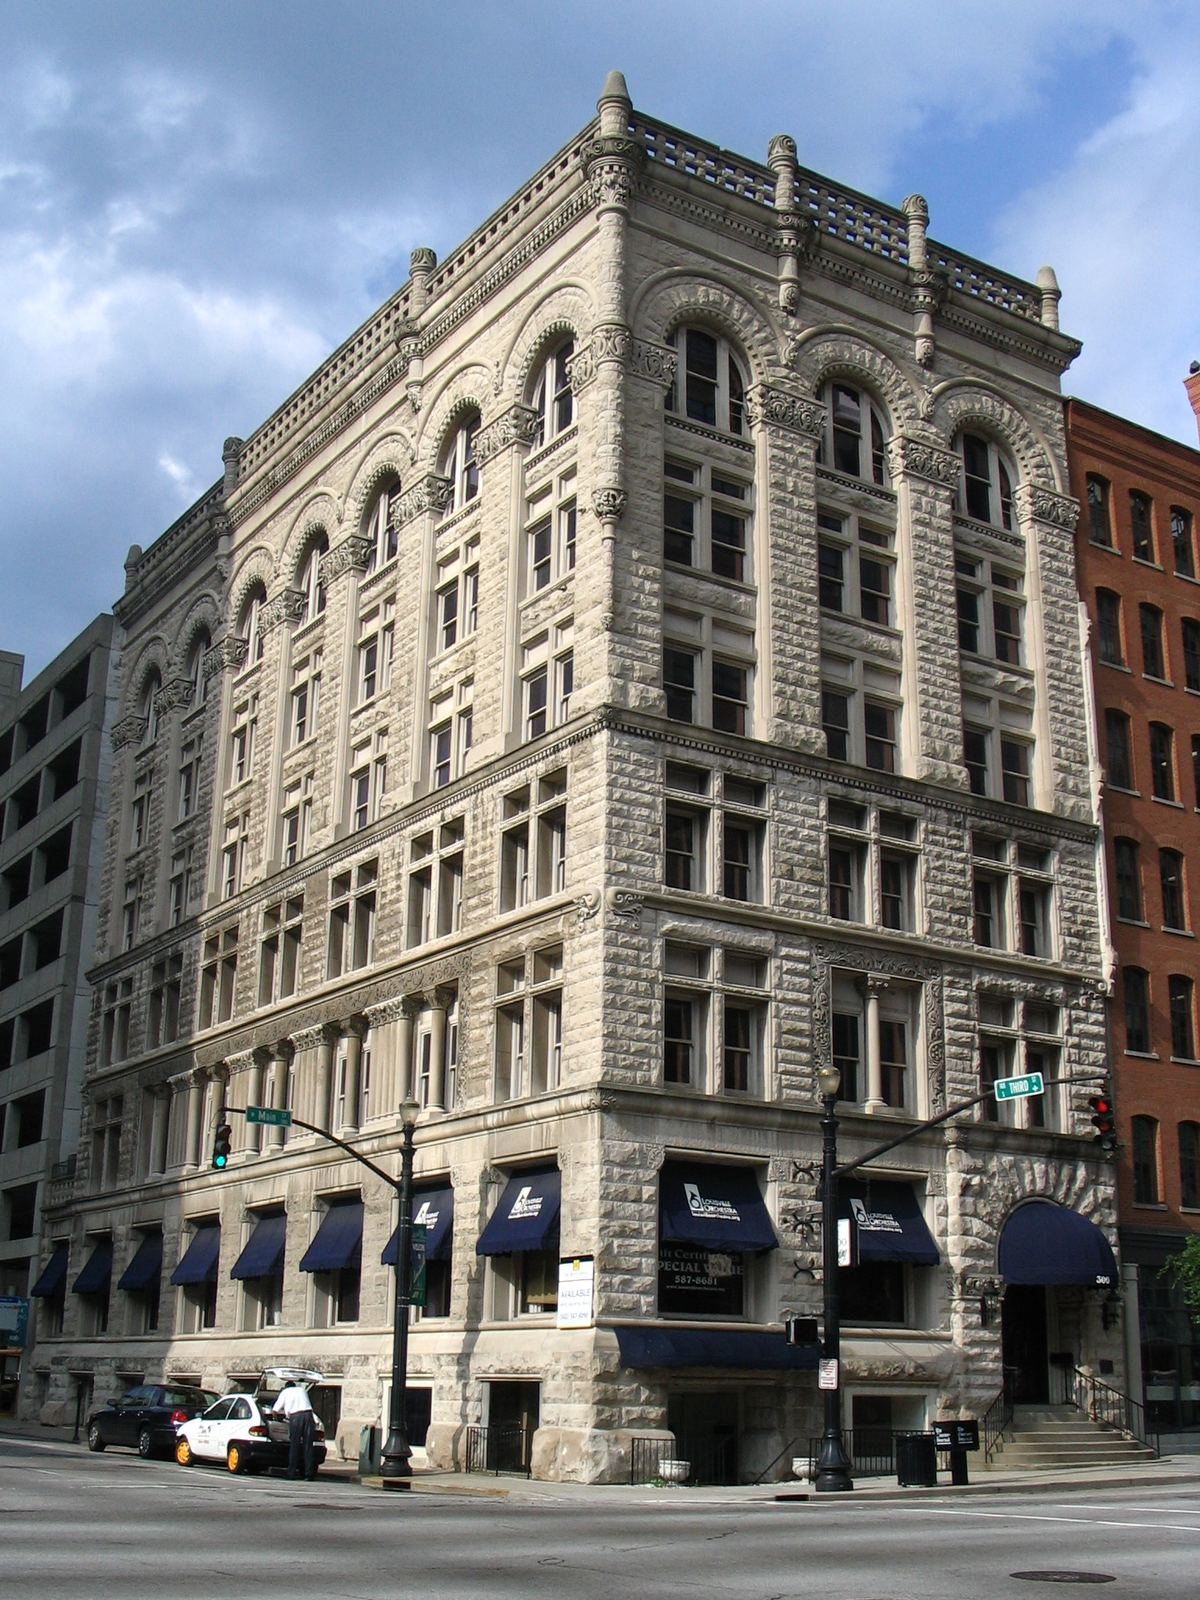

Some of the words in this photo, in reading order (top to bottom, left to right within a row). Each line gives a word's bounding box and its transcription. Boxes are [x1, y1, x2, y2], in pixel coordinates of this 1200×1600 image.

[1009, 1079, 1029, 1094] THIRD
[258, 1110, 277, 1121] Main
[703, 1204, 738, 1214] ORCHESTRA
[658, 1260, 701, 1273] PECIAL
